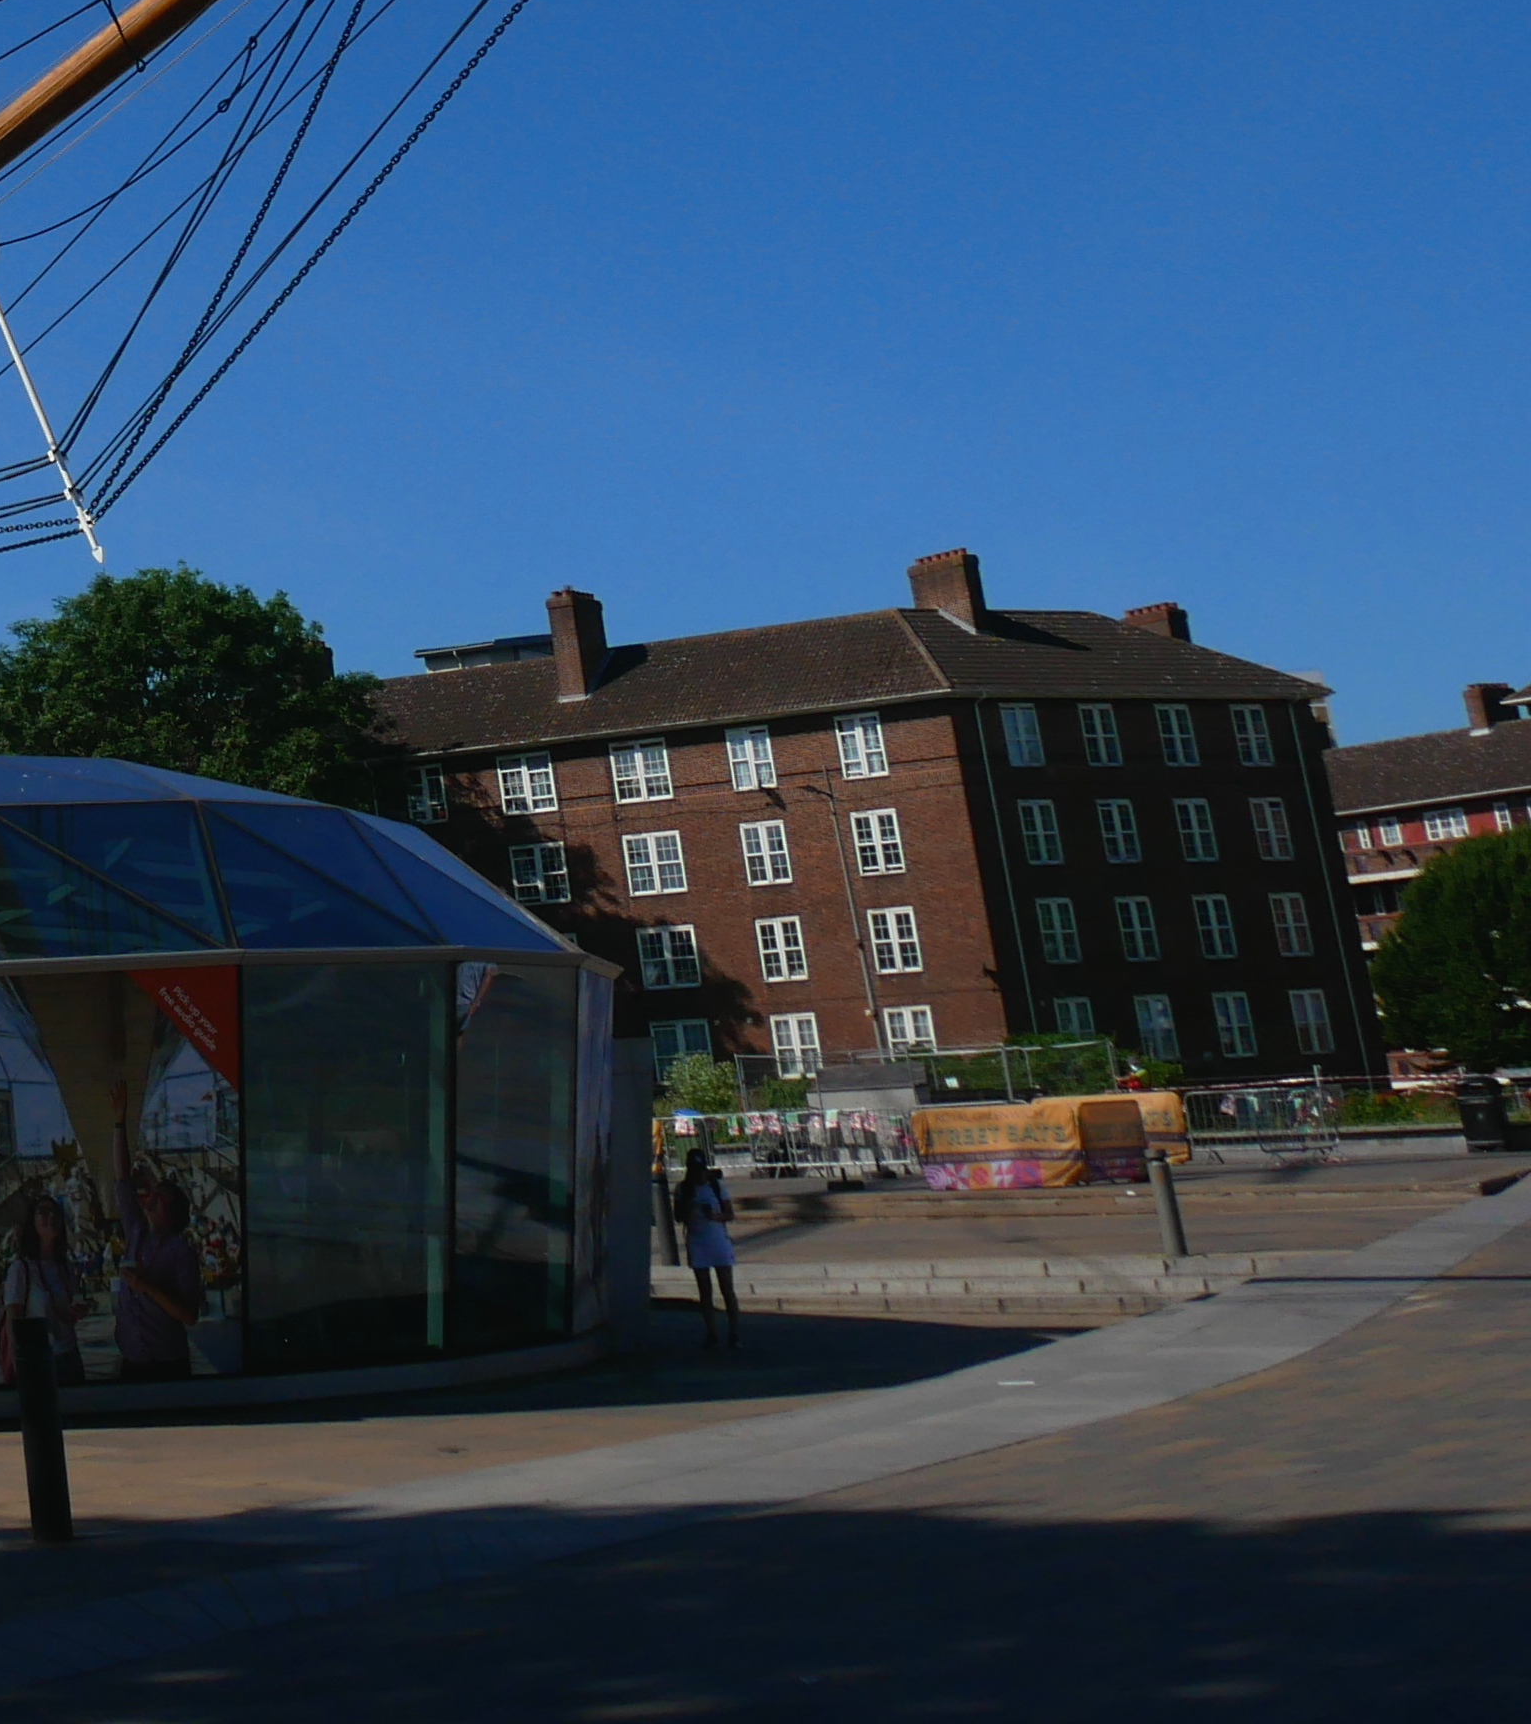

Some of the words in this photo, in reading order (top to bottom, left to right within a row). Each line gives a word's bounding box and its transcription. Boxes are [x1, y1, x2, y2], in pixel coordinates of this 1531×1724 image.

[158, 986, 175, 1006] free
[174, 1005, 195, 1029] audio
[193, 1027, 217, 1052] guide
[173, 985, 190, 1006] Pick
[189, 1003, 200, 1017] up
[197, 1015, 218, 1035] your
